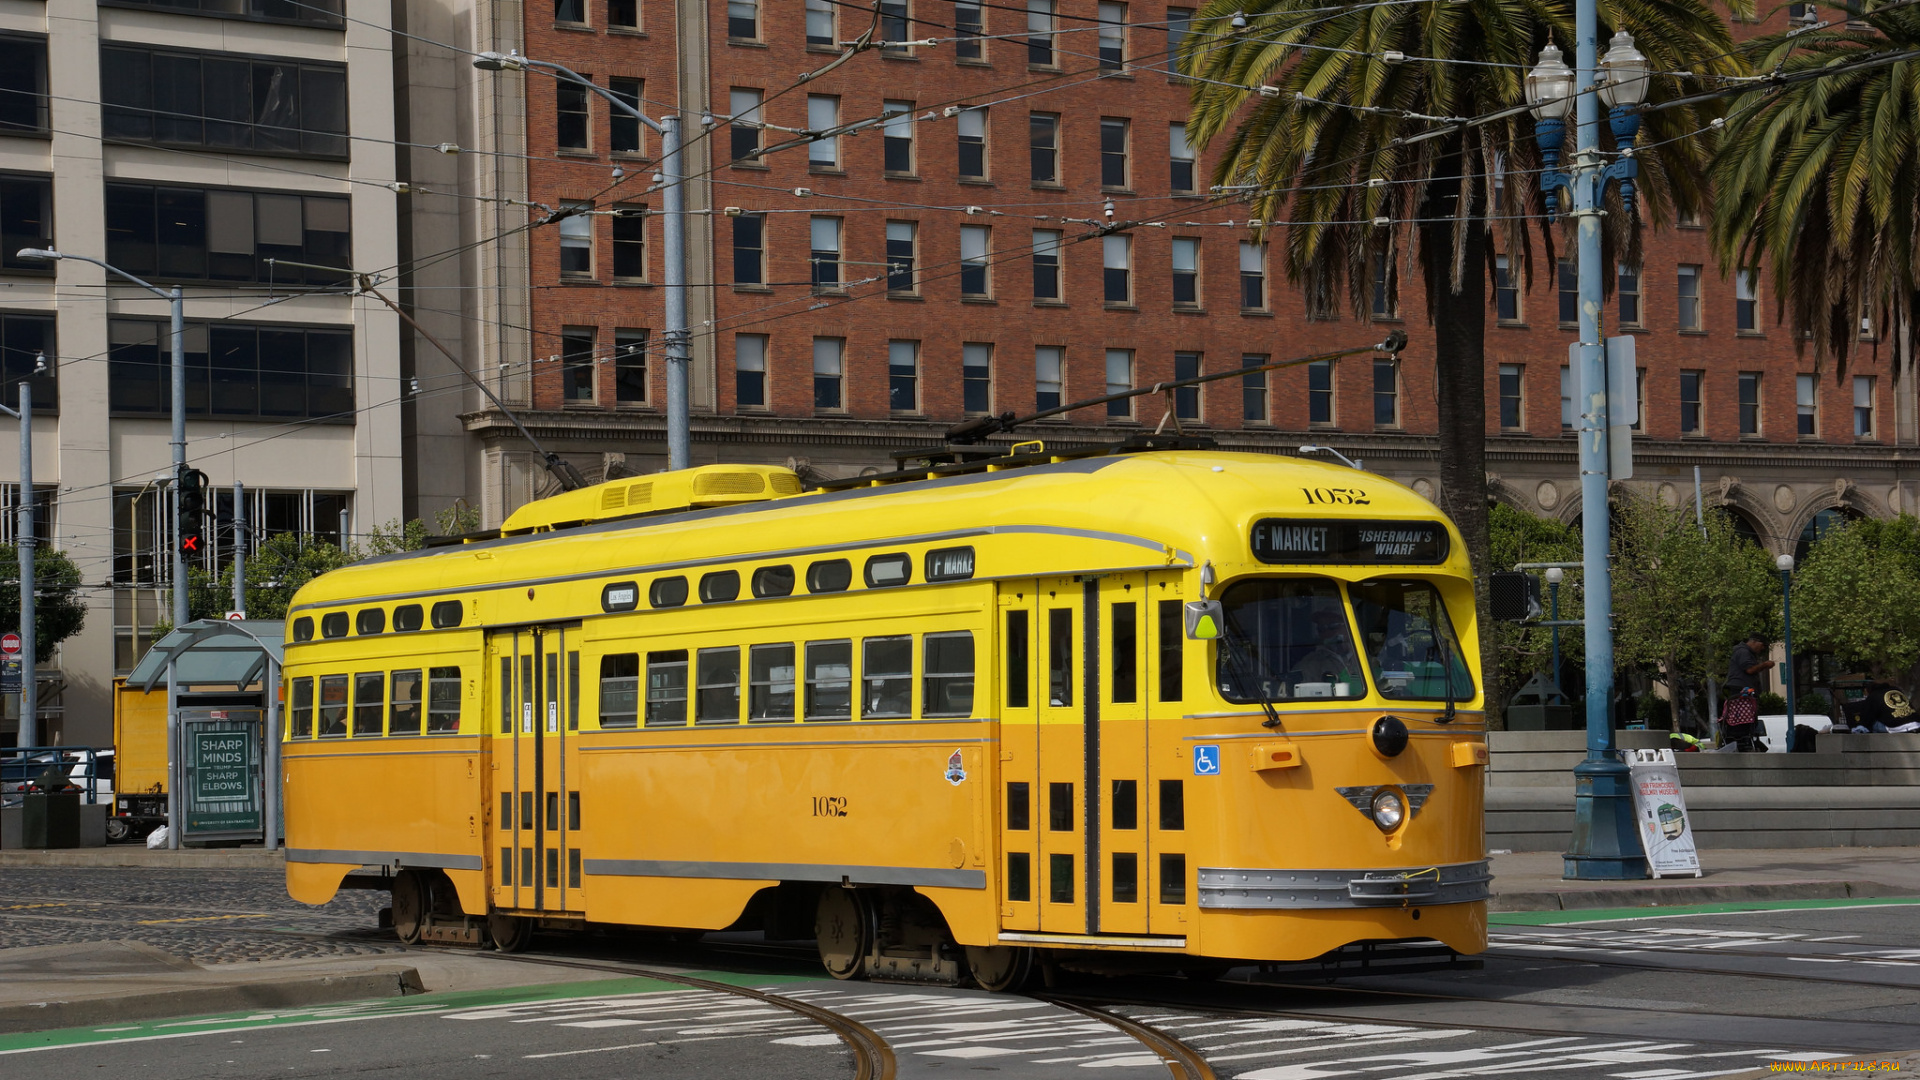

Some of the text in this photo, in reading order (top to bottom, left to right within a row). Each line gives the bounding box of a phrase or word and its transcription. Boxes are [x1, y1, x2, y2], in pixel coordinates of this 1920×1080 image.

[1299, 487, 1371, 505] 1052
[1255, 526, 1328, 551] F MARKET
[1375, 543, 1416, 556] WHARF
[201, 740, 243, 751] SHARP
[202, 752, 242, 763] MINDS
[206, 772, 238, 780] SHARP
[202, 782, 244, 790] ELBOWS.
[812, 796, 848, 817] 1052
